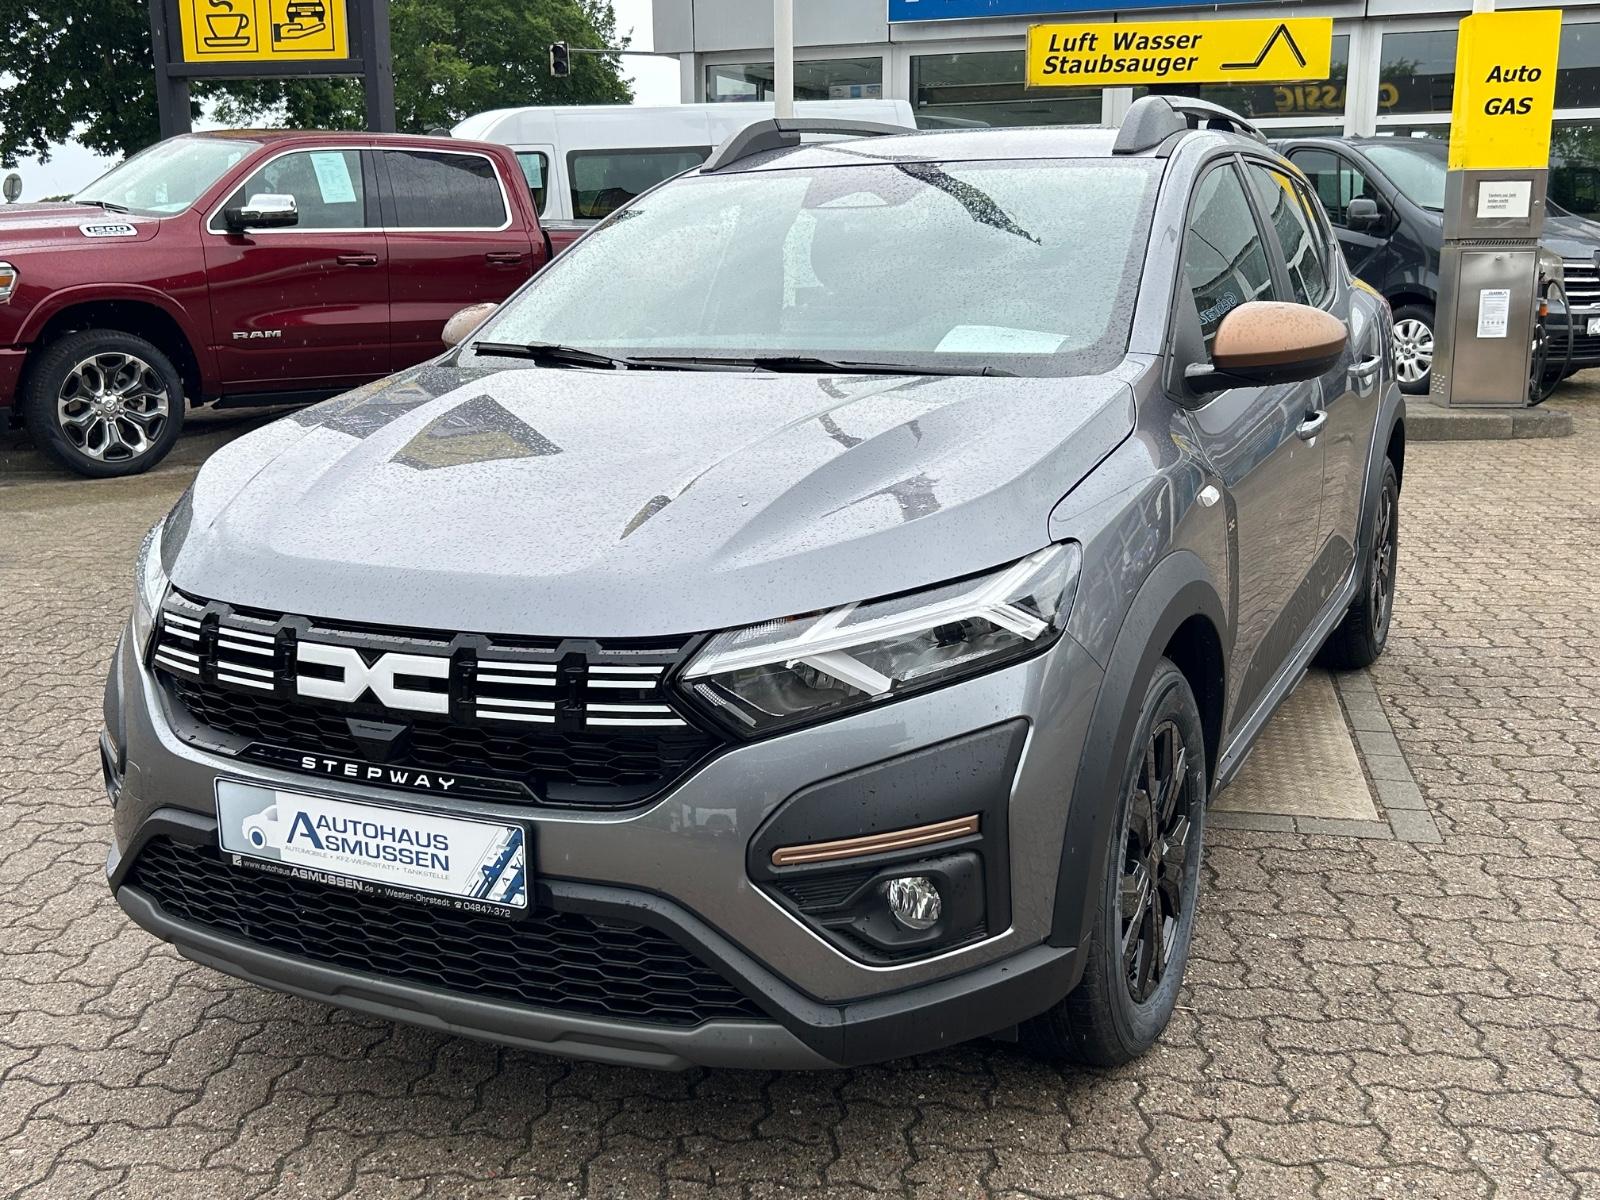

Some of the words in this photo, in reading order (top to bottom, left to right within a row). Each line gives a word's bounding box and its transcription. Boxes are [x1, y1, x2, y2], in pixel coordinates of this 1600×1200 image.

[1049, 32, 1098, 52] Luft
[1113, 32, 1202, 51] Wasser
[1043, 54, 1198, 76] Staubsauger
[1485, 65, 1542, 83] Auto
[1484, 97, 1533, 115] GAS
[87, 225, 130, 233] 1500
[232, 330, 281, 339] RAM
[301, 756, 455, 790] STEPWAY
[286, 811, 450, 871] ASMUSSEN
[316, 814, 449, 851] AUTOHAUS
[284, 845, 329, 859] AUTOMOBILE
[403, 867, 450, 881] TANKSTELLE
[463, 901, 511, 918] 04847-372
